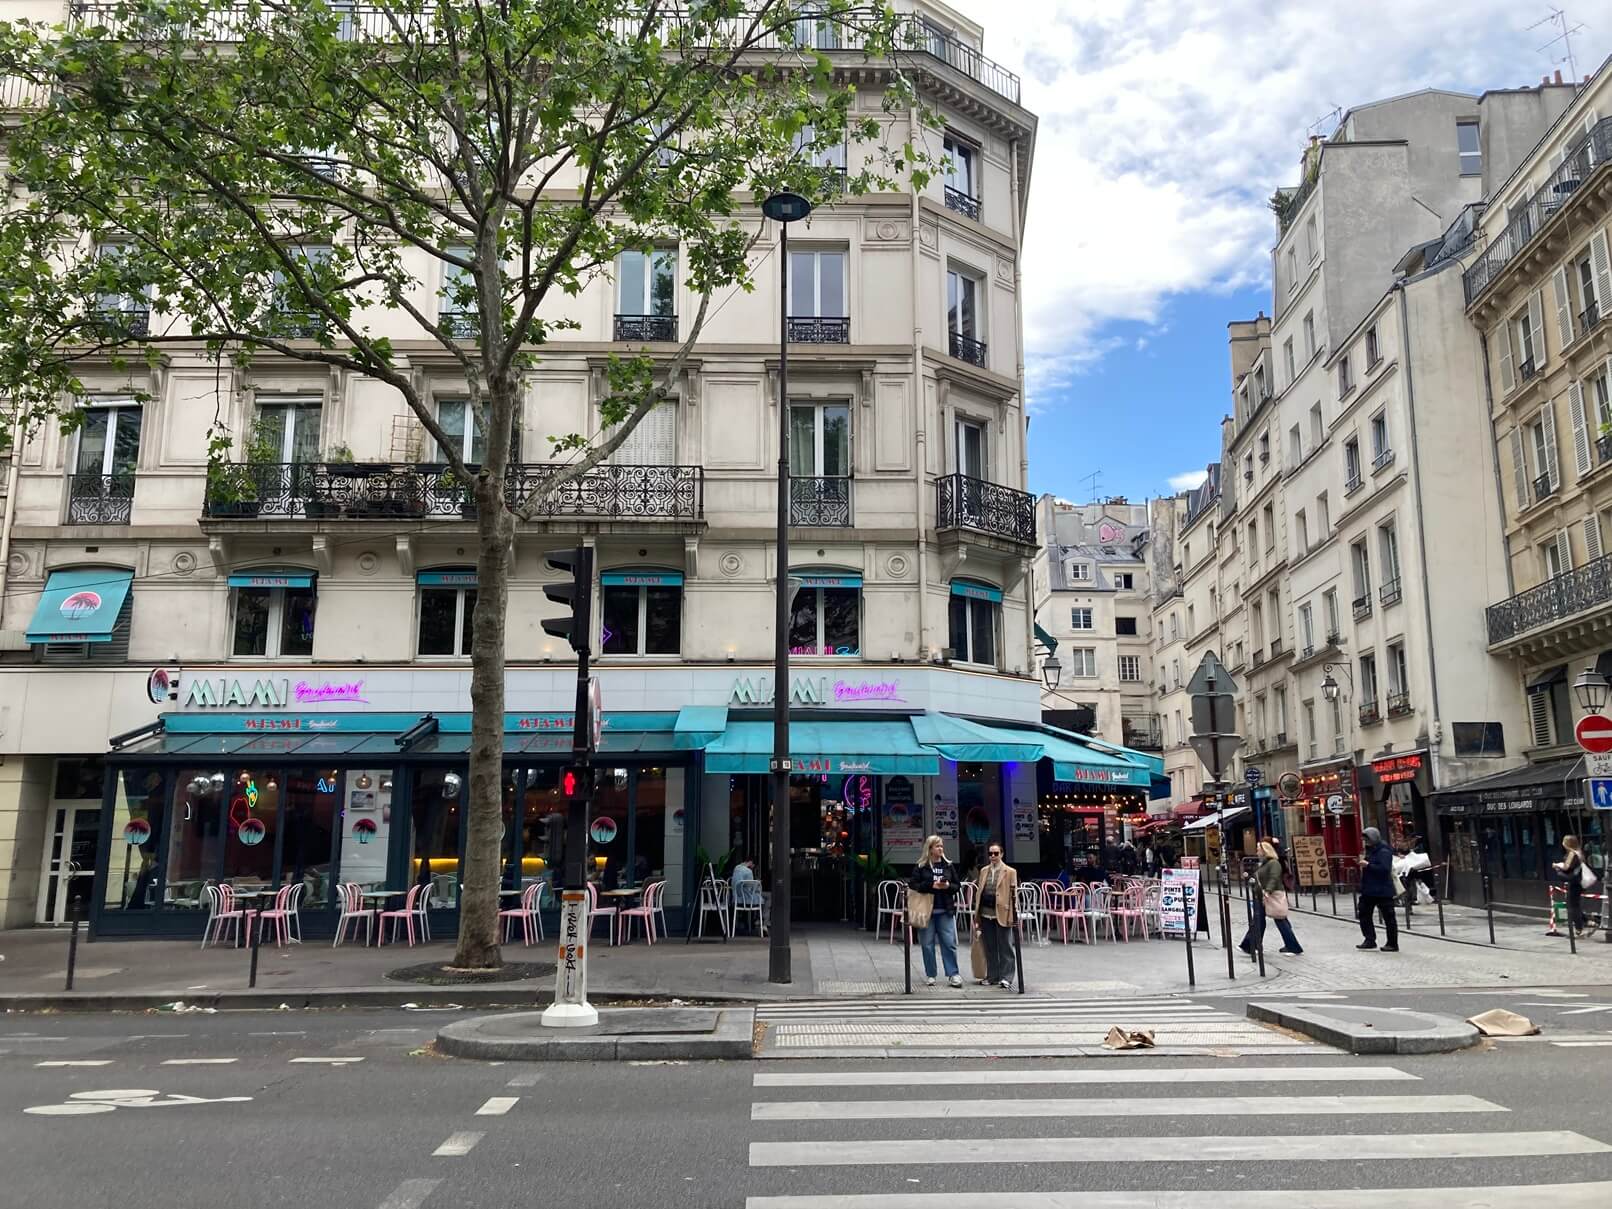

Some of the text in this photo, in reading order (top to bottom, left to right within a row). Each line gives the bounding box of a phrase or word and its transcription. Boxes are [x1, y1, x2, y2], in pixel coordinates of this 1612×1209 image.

[184, 678, 289, 707] MIAMI
[245, 718, 302, 730] MIAMI
[519, 717, 576, 729] MIAMI
[796, 759, 831, 771] AMI
[1075, 767, 1110, 781] MIAMI
